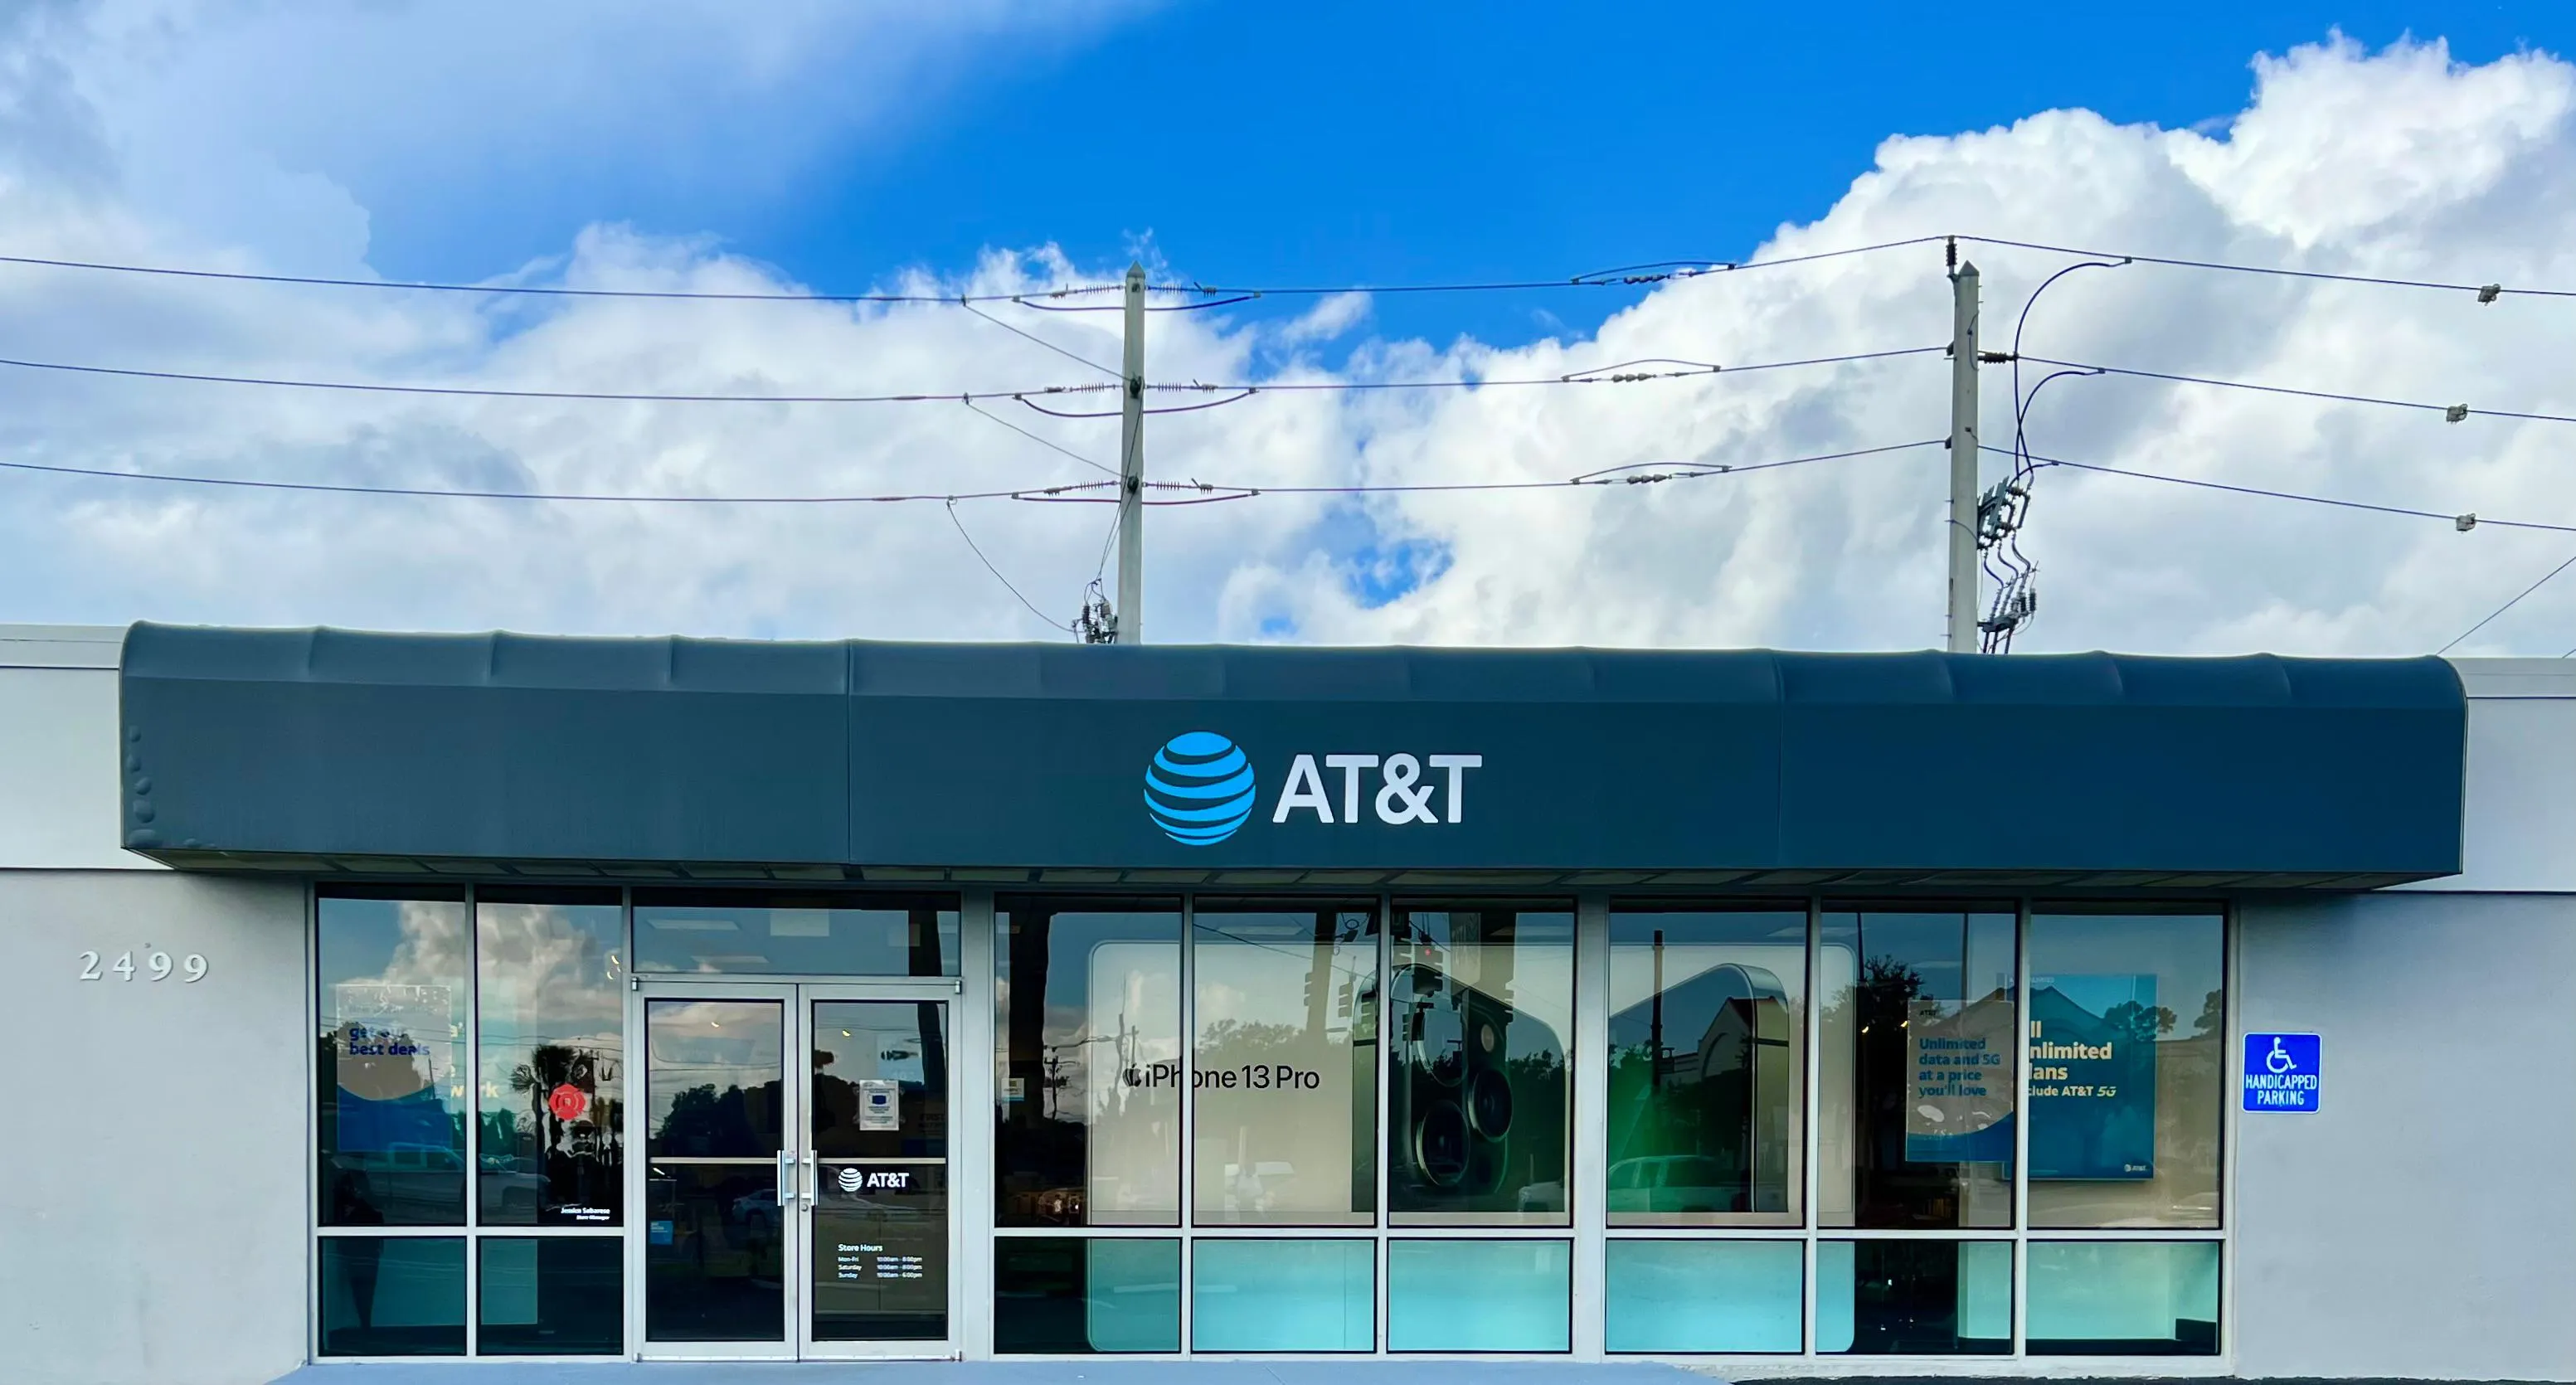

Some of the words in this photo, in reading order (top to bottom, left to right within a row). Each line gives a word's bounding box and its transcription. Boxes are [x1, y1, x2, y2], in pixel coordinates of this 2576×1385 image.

[1272, 753, 1483, 825] AT&T
[79, 950, 209, 984] 2499
[2029, 1020, 2042, 1038] ll
[349, 1042, 385, 1056] best
[388, 1042, 430, 1056] deals
[1919, 1037, 1986, 1050] Unlimited
[2029, 1041, 2112, 1060] nlimited
[1918, 1052, 1951, 1066] data
[1953, 1053, 1980, 1066] and
[1982, 1053, 2001, 1066] 5G
[1241, 1064, 1271, 1089] 13
[1276, 1065, 1320, 1090] Pro
[1918, 1070, 1933, 1081] at
[1937, 1071, 1945, 1081] a
[1948, 1068, 1982, 1084] price
[2029, 1062, 2068, 1081] lans
[2245, 1074, 2317, 1090] HANDICAPPED
[1918, 1084, 1956, 1100] you'll
[1958, 1084, 1987, 1096] love
[2062, 1086, 2094, 1097] AT&T
[2257, 1090, 2305, 1106] PARKING
[867, 1172, 910, 1188] AT&T
[838, 1243, 859, 1251] Store
[860, 1243, 883, 1252] Hours
